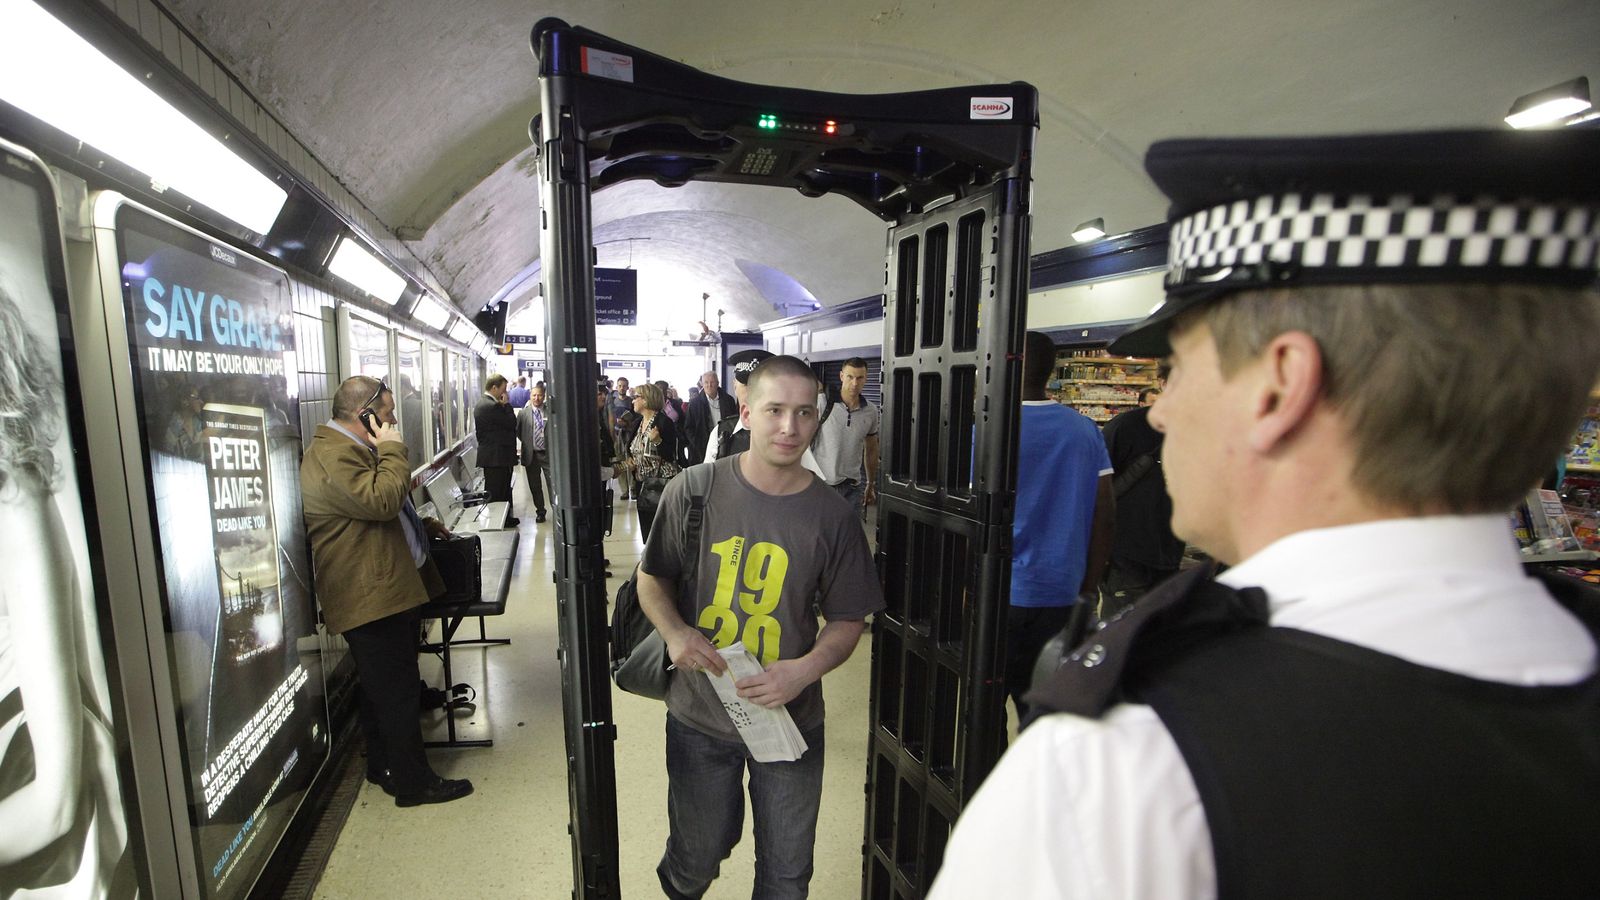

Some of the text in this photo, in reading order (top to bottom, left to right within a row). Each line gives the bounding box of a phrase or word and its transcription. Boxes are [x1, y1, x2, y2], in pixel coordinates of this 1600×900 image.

[143, 277, 283, 351] SAY GRACE
[148, 347, 283, 376] IT MAY BE YOUR ONLY HOPE
[209, 436, 261, 470] PETER
[213, 476, 264, 510] JAMES
[217, 515, 267, 533] DEAD LIKE YOU
[730, 539, 743, 567] SINCE
[200, 663, 302, 788] IN A DESPERATE HUNT FOR THE TRUTH
[203, 669, 308, 804] DETECTIVE SUPERINTENDENT ROY GRACE
[207, 699, 295, 819] REOPENS A CHILLING COLD CASE
[213, 814, 254, 878] DEAD LIKE YOU
